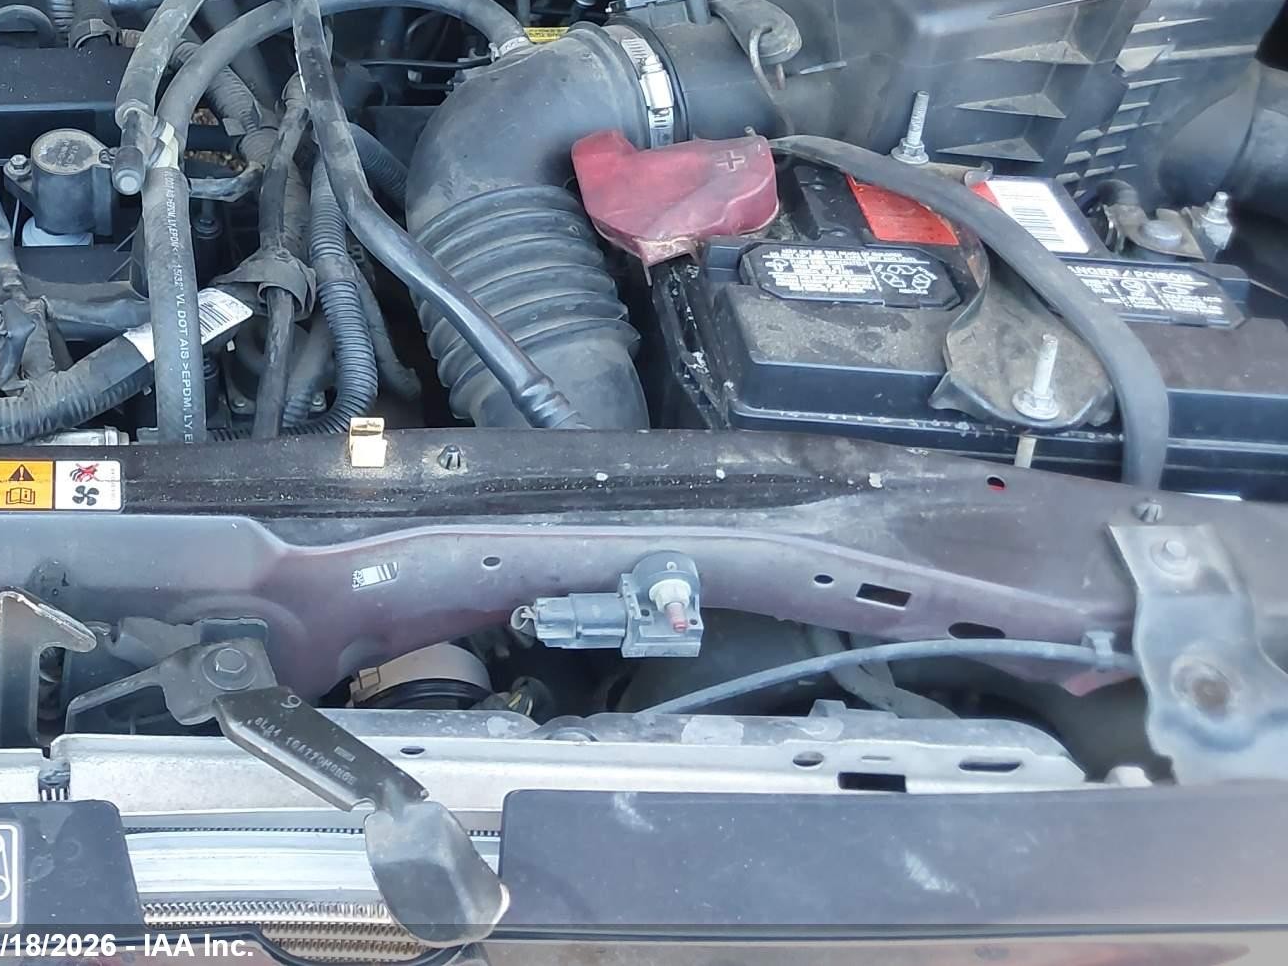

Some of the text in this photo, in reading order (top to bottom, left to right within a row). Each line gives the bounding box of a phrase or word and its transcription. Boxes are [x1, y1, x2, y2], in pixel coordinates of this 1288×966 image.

[176, 293, 185, 308] VL
[176, 310, 189, 337] DOT
[178, 339, 190, 360] AIS
